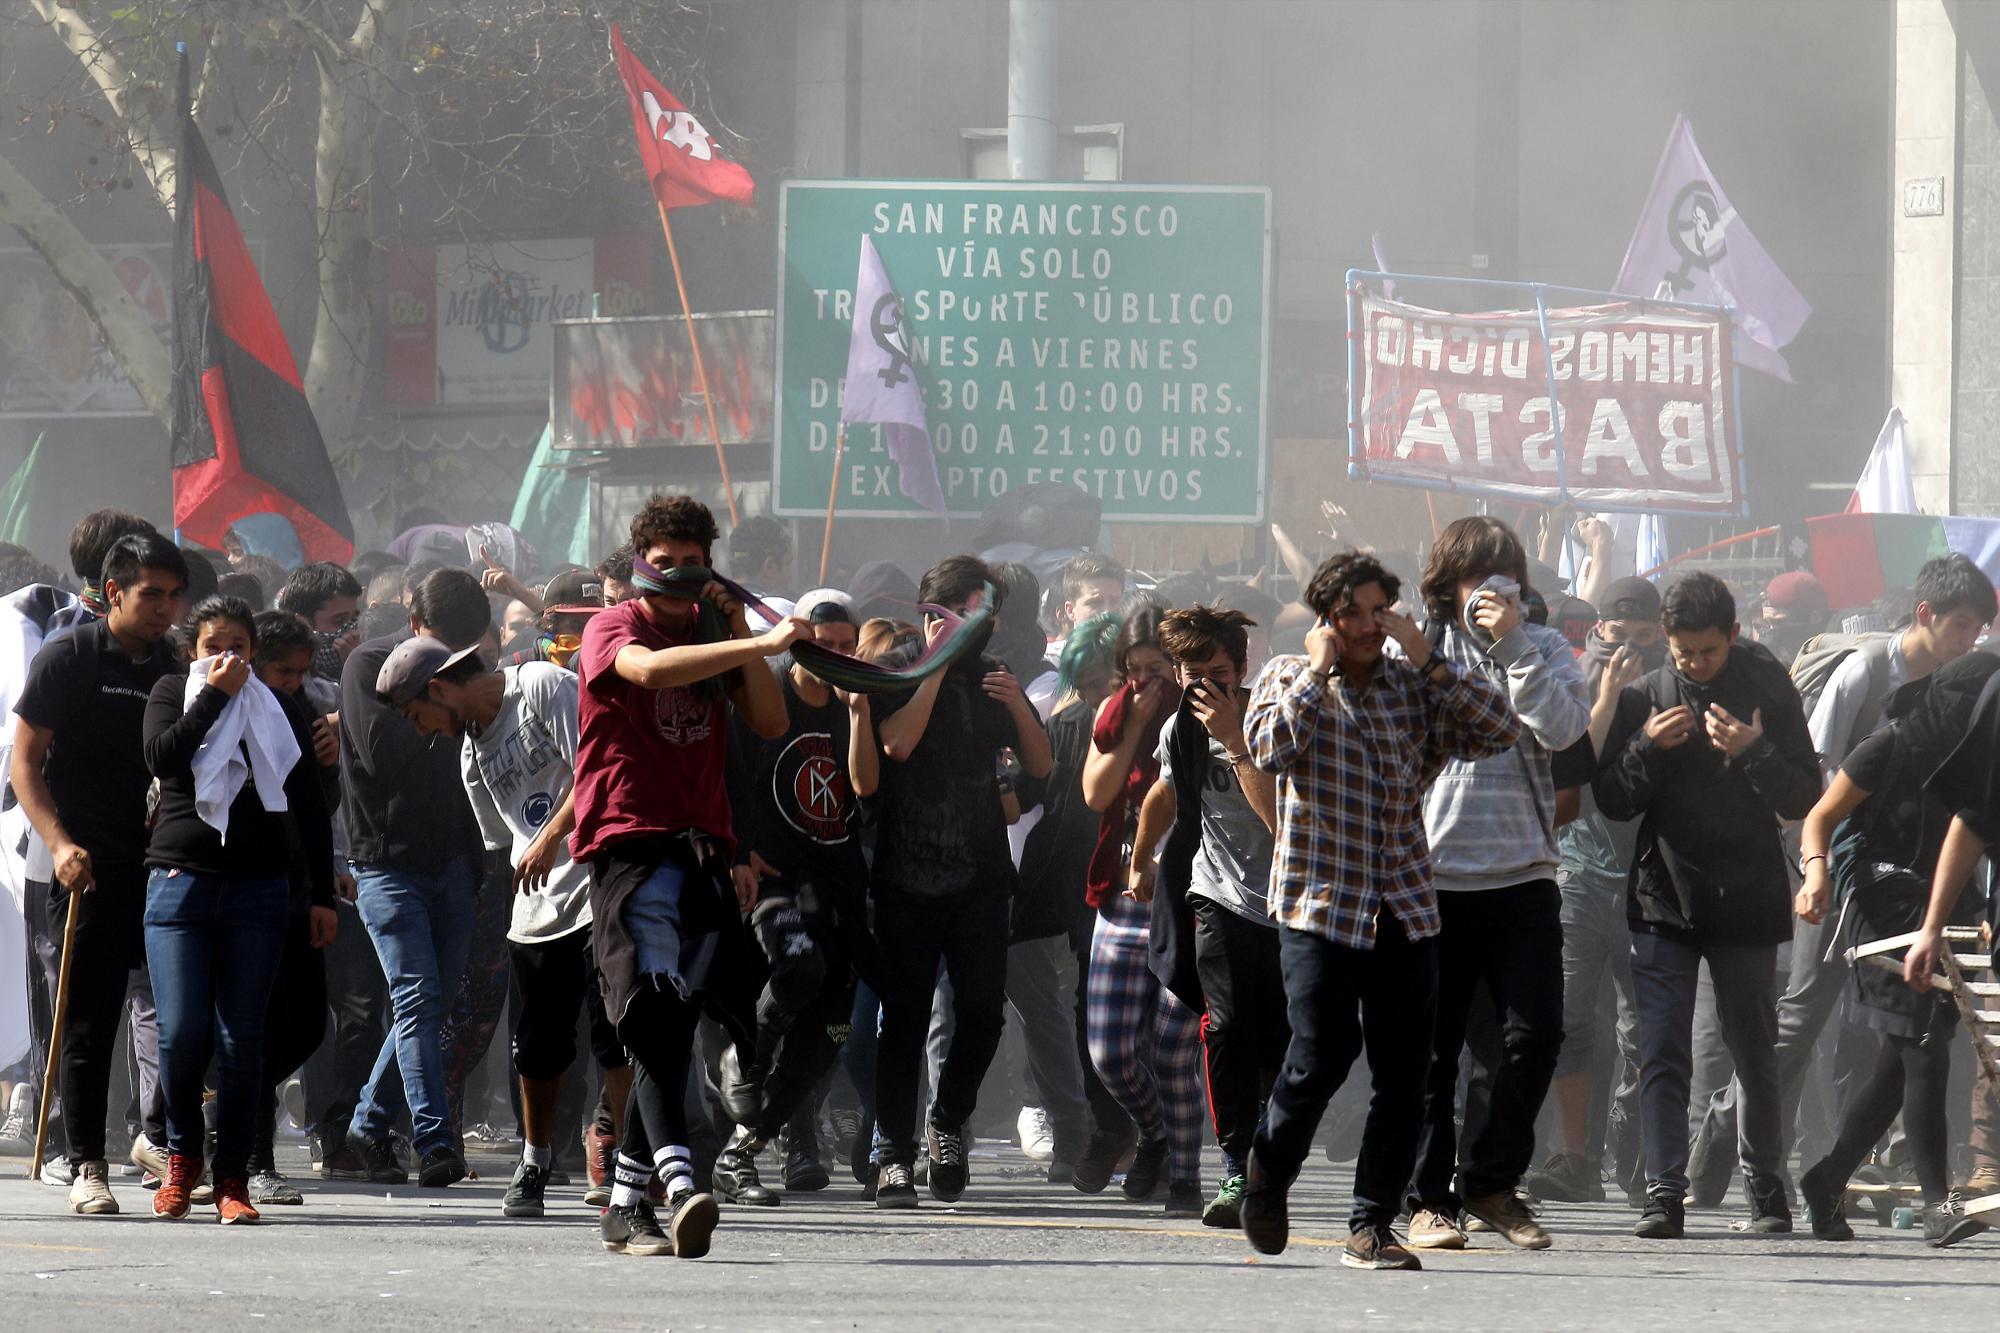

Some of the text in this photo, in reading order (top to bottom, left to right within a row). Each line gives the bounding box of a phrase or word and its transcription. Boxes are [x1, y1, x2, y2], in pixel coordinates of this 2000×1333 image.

[1911, 185, 1936, 208] 776
[873, 202, 1178, 236] SAN FRANCISCO
[936, 240, 1112, 280] VÍA SOLO
[813, 288, 1050, 323] TRSPORTE
[911, 335, 1199, 370] NES A VIERNES
[995, 380, 1016, 411] A
[1034, 381, 1143, 413] 10:00
[1162, 382, 1243, 414] HRS.
[994, 424, 1016, 455] A
[1033, 424, 1142, 456] 21:00
[1161, 425, 1243, 458] HRS.
[851, 464, 1008, 498] EXPTO
